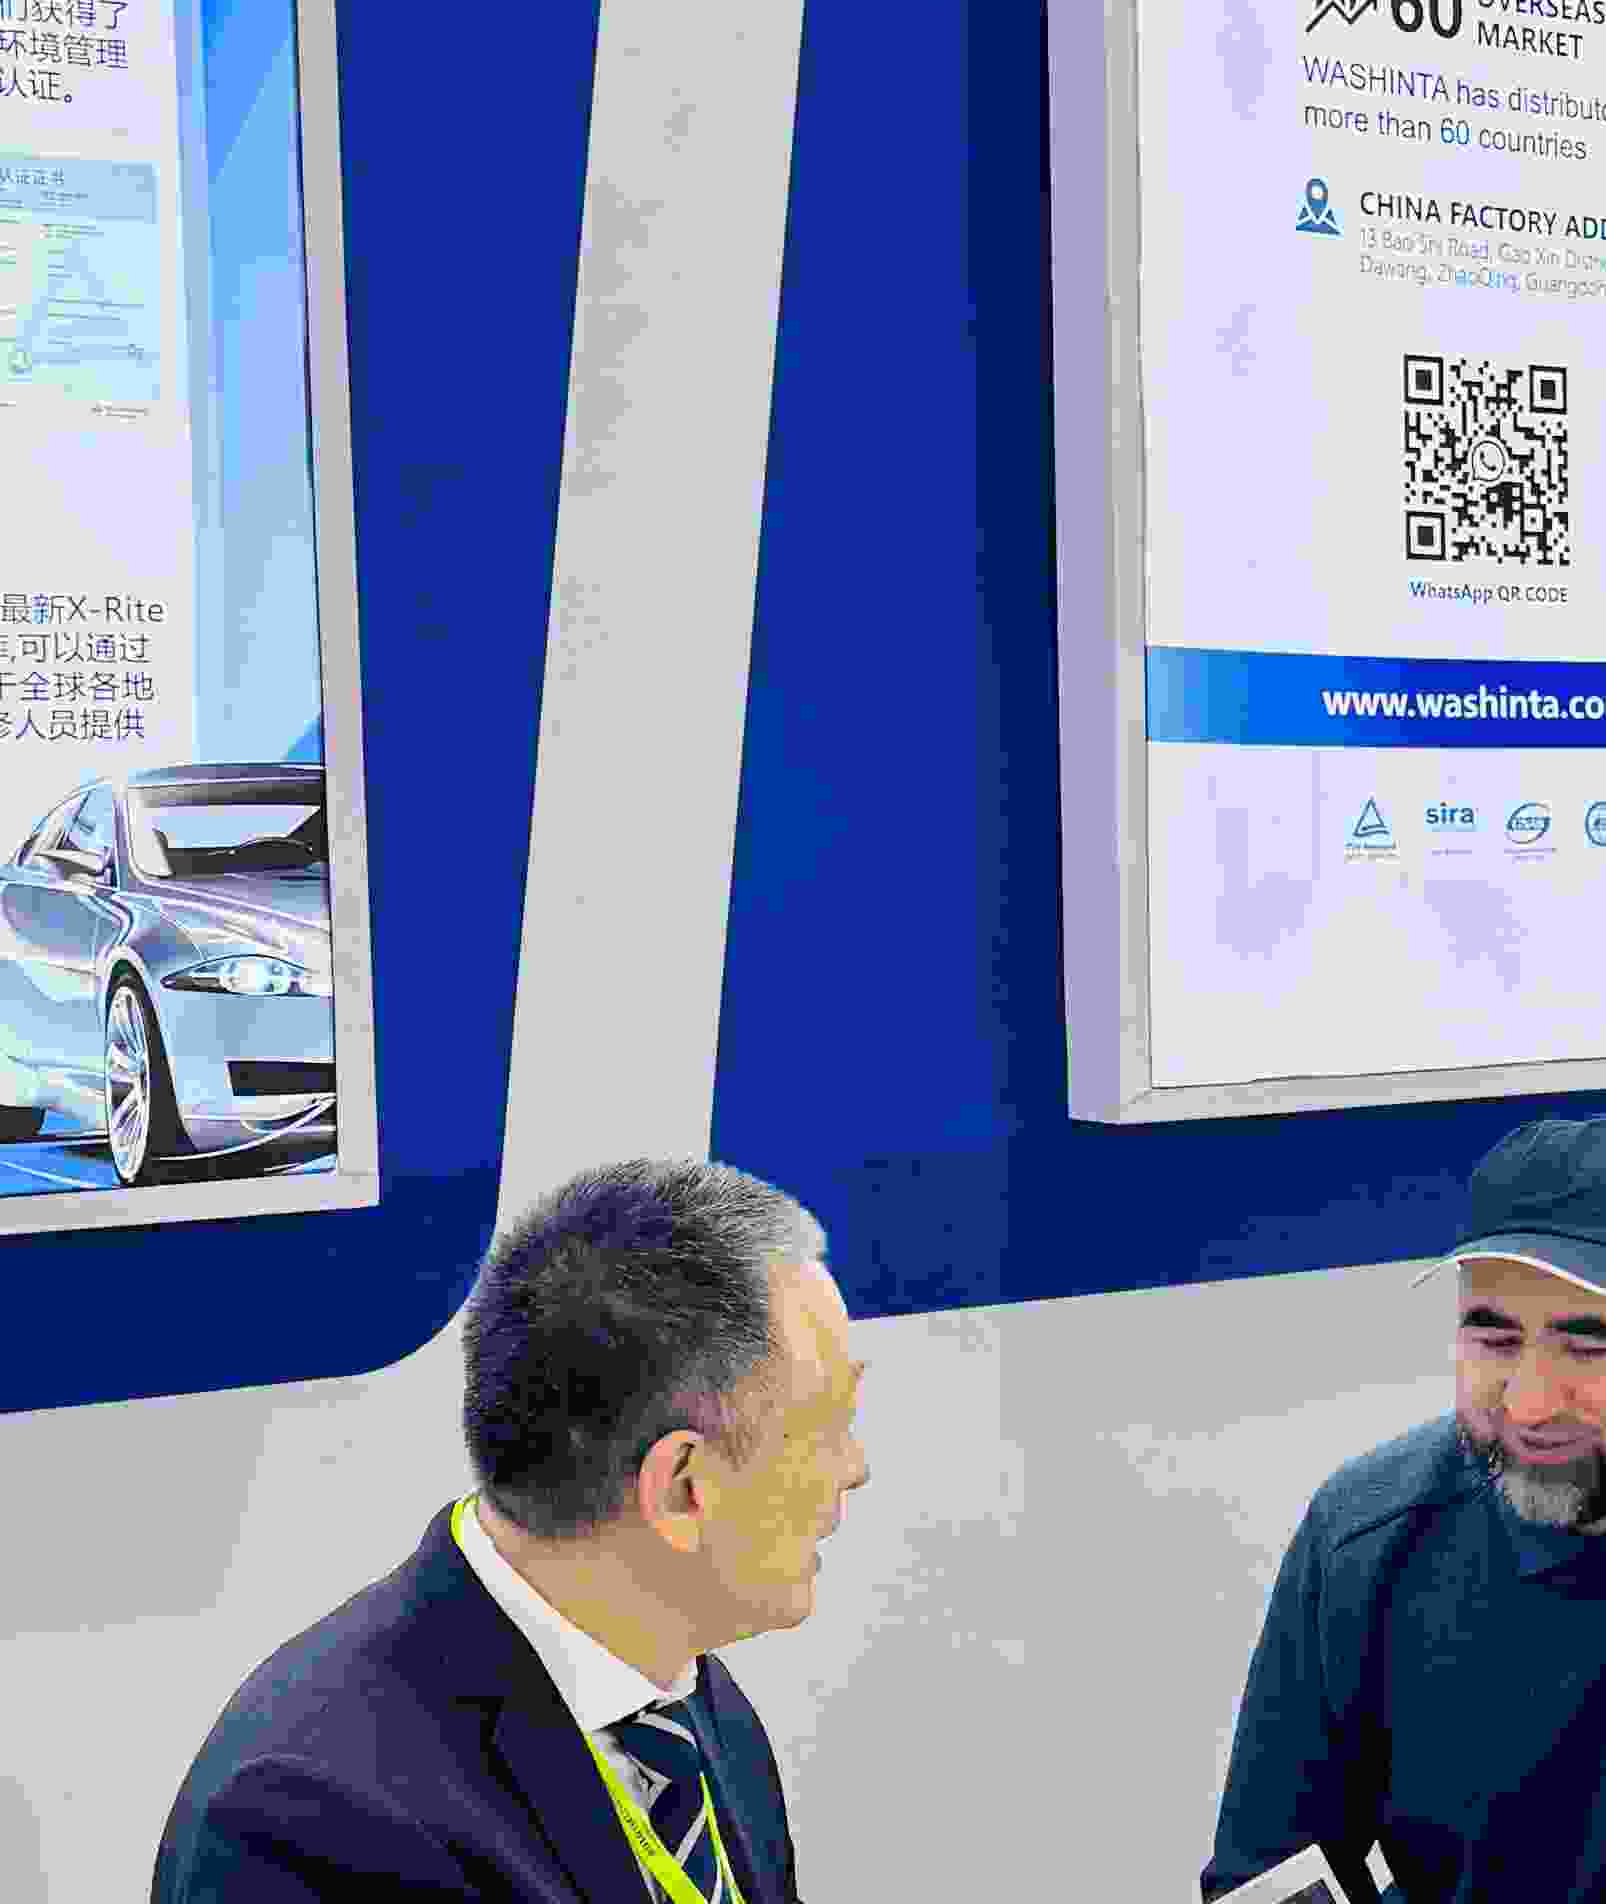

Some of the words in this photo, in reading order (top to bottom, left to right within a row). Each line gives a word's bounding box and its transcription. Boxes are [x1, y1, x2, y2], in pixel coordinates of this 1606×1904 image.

[1477, 21, 1584, 60] MARKET
[1303, 55, 1450, 103] WASHINTA
[1456, 79, 1500, 110] has
[1303, 104, 1369, 133] more
[1377, 111, 1432, 143] than
[1440, 117, 1473, 146] 60
[1478, 126, 1588, 160] countries
[1360, 191, 1442, 224] CHINA
[1450, 201, 1558, 235] FACTORY
[1409, 580, 1493, 605] WhatsApp
[1498, 584, 1521, 603] QR
[1525, 586, 1569, 603] CODE
[1425, 800, 1475, 825] sira
